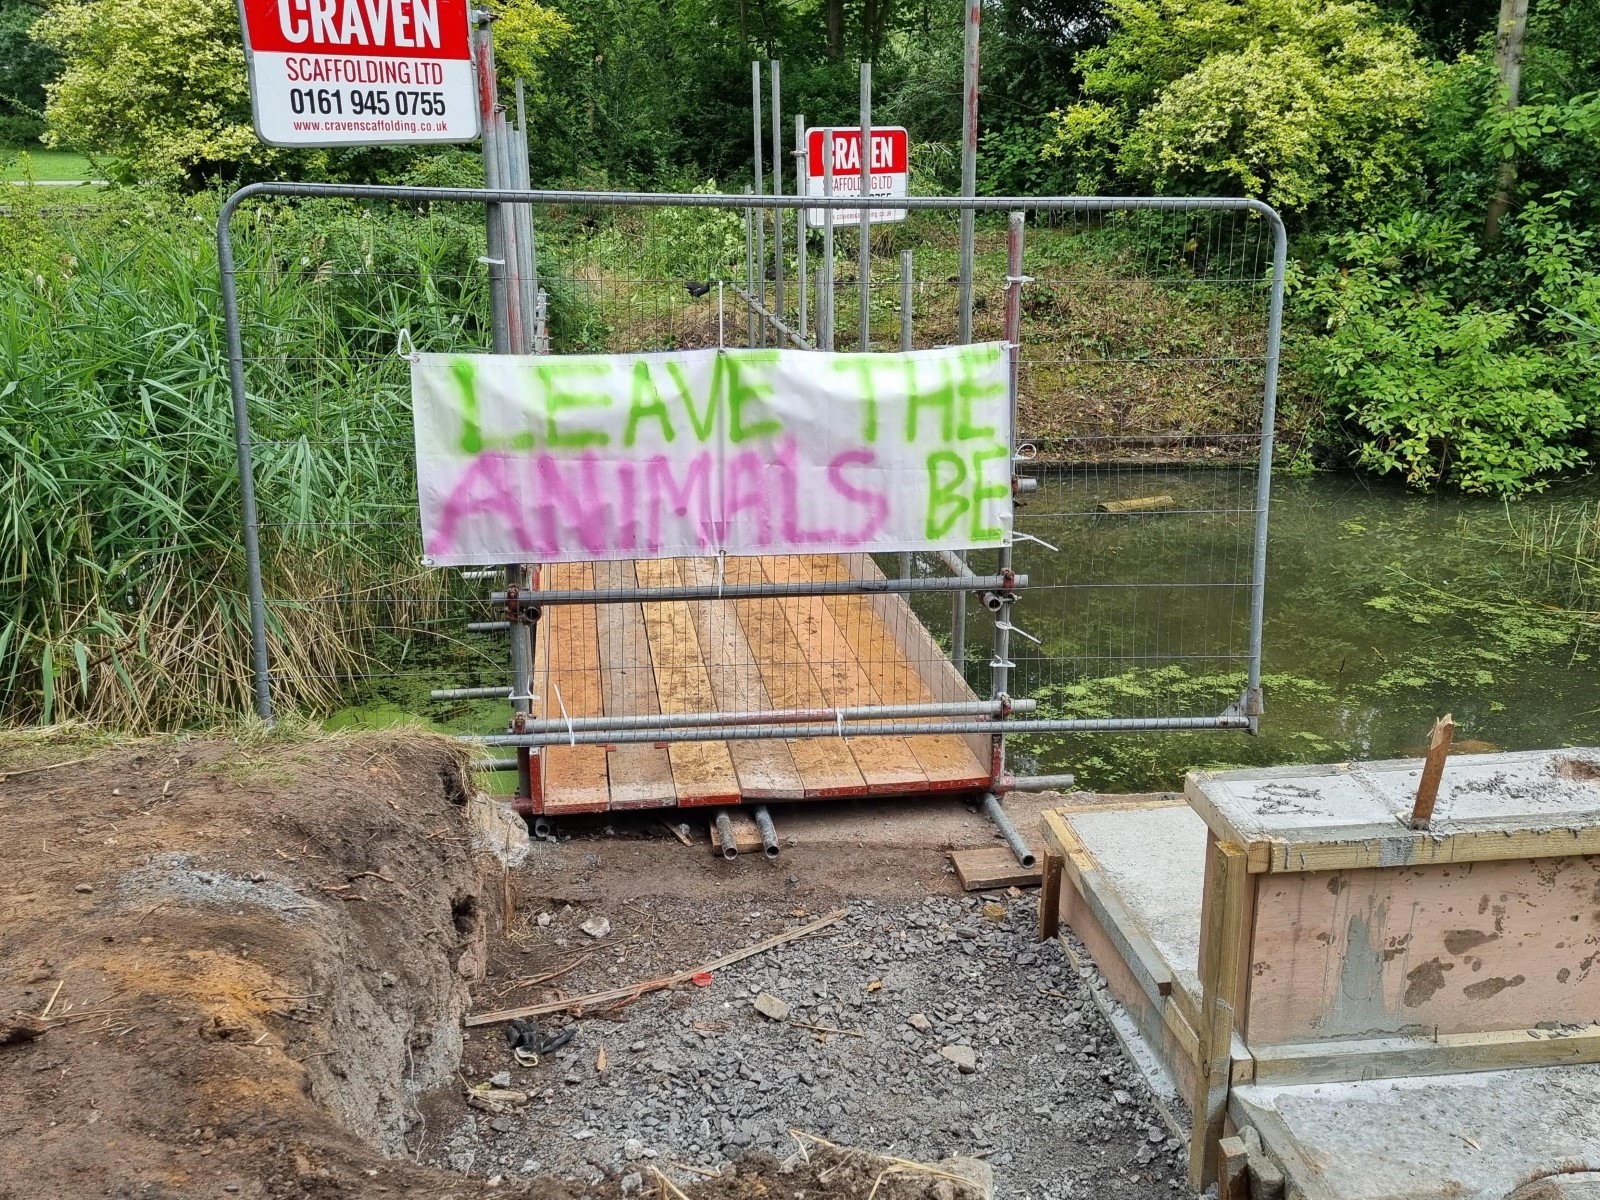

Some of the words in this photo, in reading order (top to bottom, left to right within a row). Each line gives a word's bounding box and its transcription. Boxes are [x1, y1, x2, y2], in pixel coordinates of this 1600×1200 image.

[277, 0, 442, 49] CRAVEN
[285, 57, 411, 85] SCAFFOLDING
[414, 62, 443, 85] LTD
[290, 88, 343, 115] 0161
[350, 89, 390, 116] 945
[395, 91, 446, 116] 0755
[293, 119, 448, 134] www.cravenscaffolding.co.uk
[822, 136, 893, 170] RAEN
[879, 175, 893, 190] LTD
[451, 350, 783, 454] LEAVE
[831, 347, 1005, 443] THE
[427, 434, 889, 556] ANIMALS
[925, 445, 1009, 542] BE
